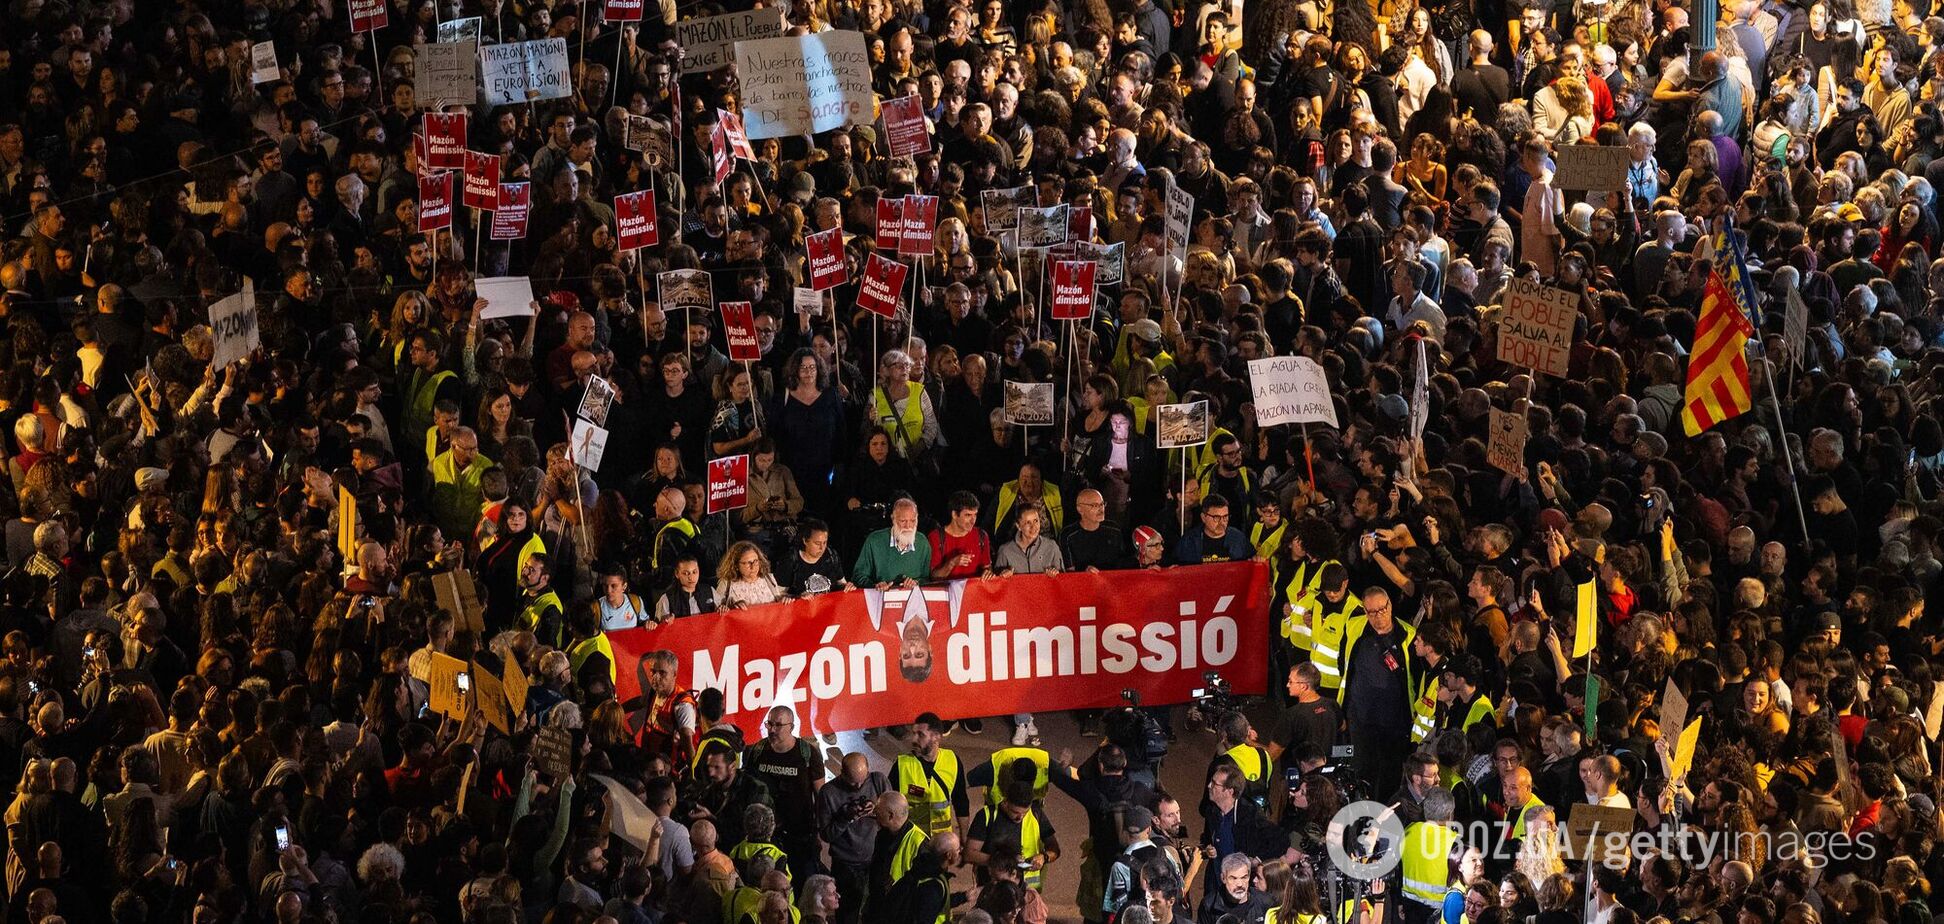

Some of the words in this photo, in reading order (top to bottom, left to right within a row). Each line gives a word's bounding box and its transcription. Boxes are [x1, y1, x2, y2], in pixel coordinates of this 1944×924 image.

[353, 4, 384, 19] dimissió
[745, 14, 782, 35] PUEBLO
[527, 40, 564, 57] MAMÓN!
[502, 60, 531, 75] VETE
[537, 59, 546, 70] A
[682, 51, 717, 69] EXIGE
[747, 52, 816, 73] Nuestras
[823, 52, 866, 65] manos
[745, 72, 784, 90] están
[795, 65, 861, 82] manchadas
[749, 91, 765, 105] de
[429, 135, 455, 145] Mazón
[430, 144, 464, 154] dimissió
[466, 173, 489, 186] Mazón
[465, 184, 497, 197] dimissió
[422, 197, 444, 209] Mazón
[421, 204, 450, 219] dimissió
[619, 214, 645, 228] Mazón
[879, 219, 900, 229] Mazó
[904, 218, 926, 229] Mazón
[620, 222, 654, 238] dimissió
[903, 229, 932, 240] dimissió
[812, 254, 836, 268] Mazón
[813, 260, 844, 278] dimissió
[865, 275, 890, 293] Mazón
[1056, 284, 1083, 295] Mazón
[863, 285, 896, 305] dimissió
[1055, 294, 1090, 305] dimissió
[1559, 292, 1575, 309] EL
[1509, 296, 1571, 330] POBLE
[727, 325, 747, 336] Mazón
[1502, 316, 1550, 343] SALVA
[1552, 333, 1568, 350] AL
[730, 336, 756, 346] dimissió
[1502, 335, 1560, 375] POBLE
[1250, 364, 1265, 376] EL
[1269, 360, 1302, 373] AGUA
[1253, 386, 1267, 399] LA
[1268, 382, 1298, 395] RIADA
[1257, 403, 1290, 420] MAZÓN
[1291, 404, 1302, 415] NI
[711, 478, 736, 492] Mazón
[711, 485, 745, 500] dimissió
[691, 624, 887, 715] Mazón
[947, 594, 1238, 685] dimissió
[766, 764, 798, 776] PASSAREU
